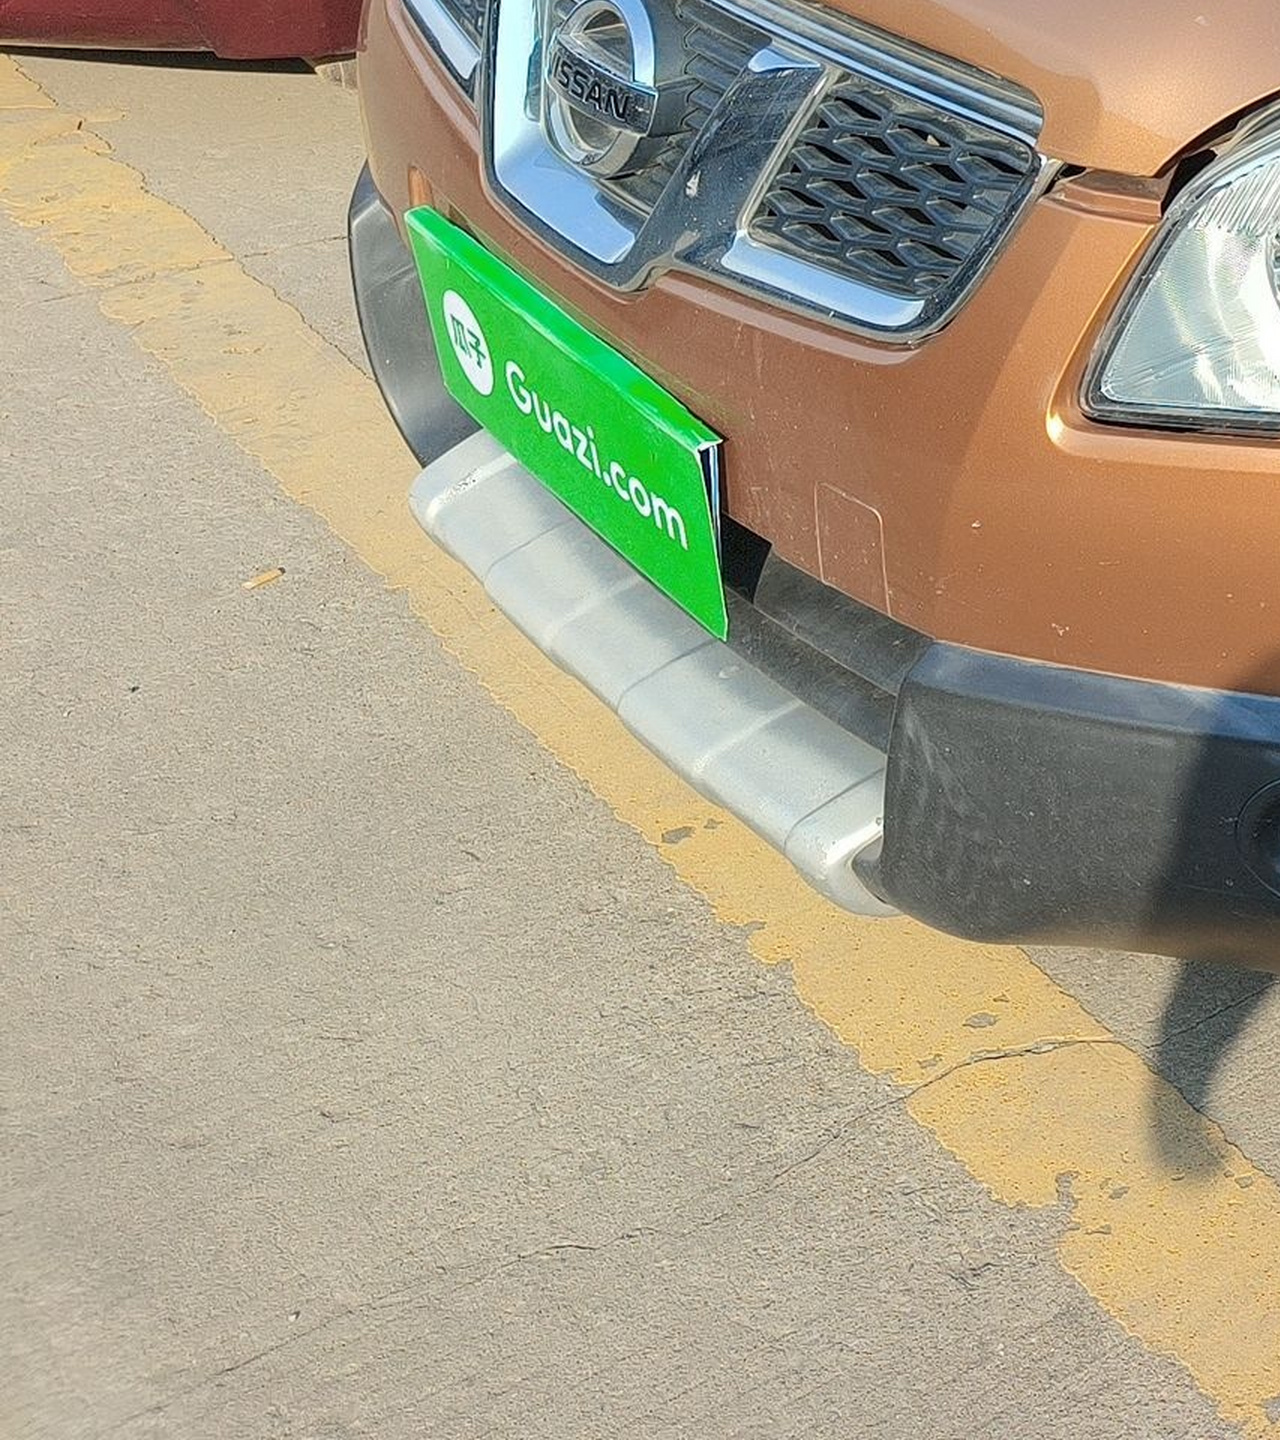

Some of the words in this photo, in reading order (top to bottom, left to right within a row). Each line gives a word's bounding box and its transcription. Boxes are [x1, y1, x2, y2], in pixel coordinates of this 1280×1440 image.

[552, 51, 630, 122] ISSAN
[450, 314, 487, 370] 瓜子
[505, 360, 689, 551] Guazi.com
